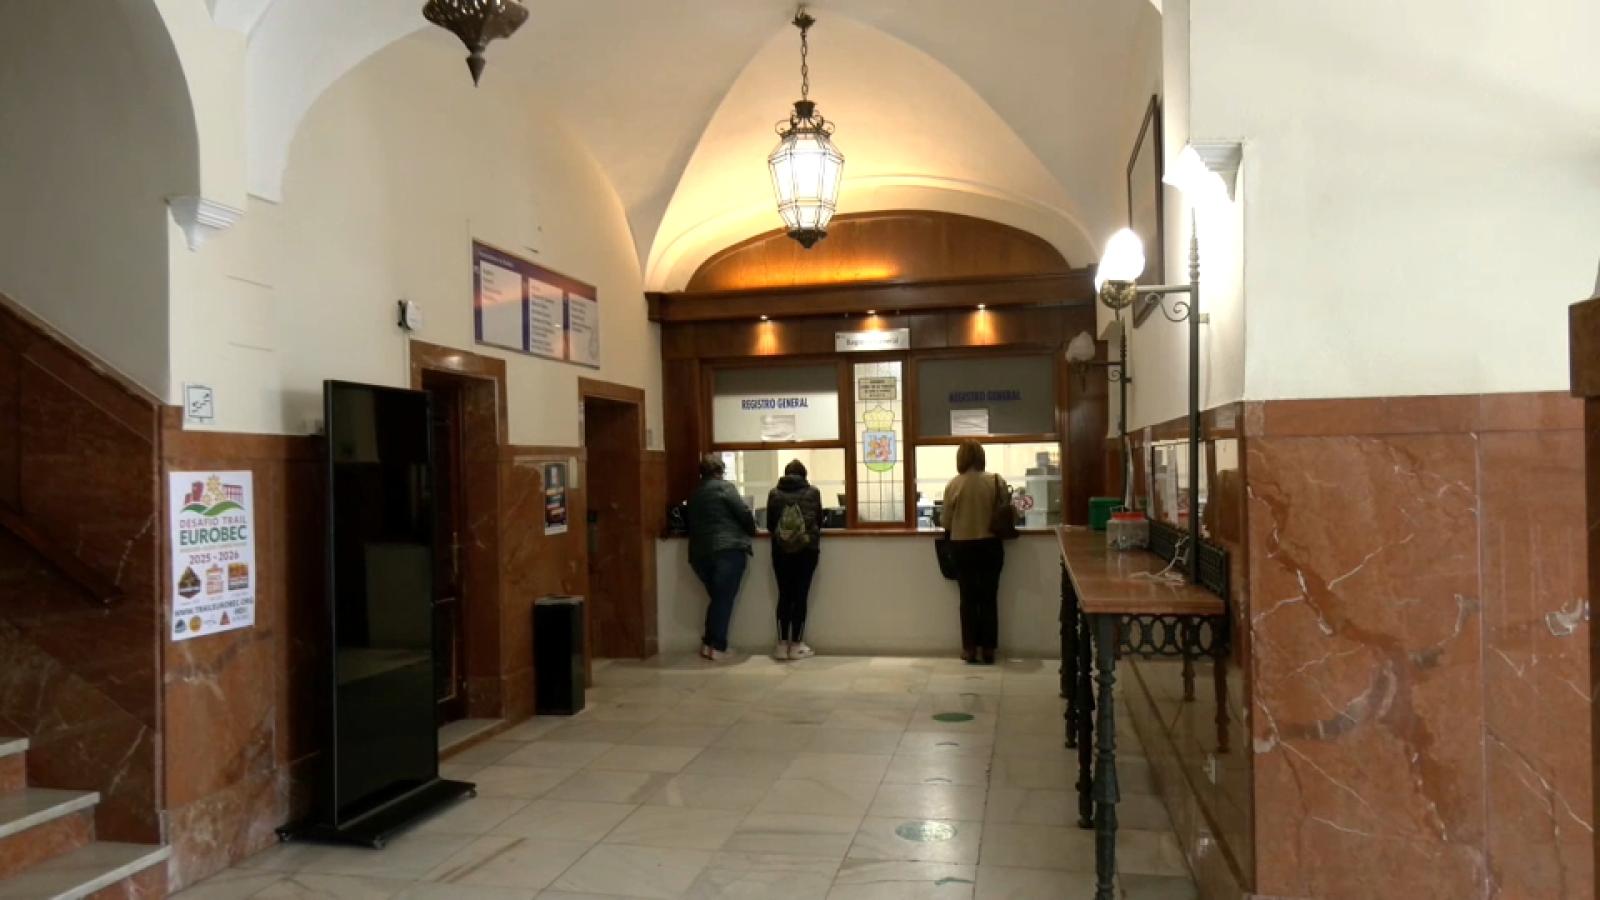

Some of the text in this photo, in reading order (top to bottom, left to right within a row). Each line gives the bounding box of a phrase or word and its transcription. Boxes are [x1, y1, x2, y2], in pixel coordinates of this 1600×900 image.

[741, 397, 808, 410] REGISTRO GENERAL
[222, 515, 247, 525] TRAIL
[179, 524, 248, 546] EUROBEC
[189, 553, 211, 565] 2025
[218, 551, 240, 562] 2026
